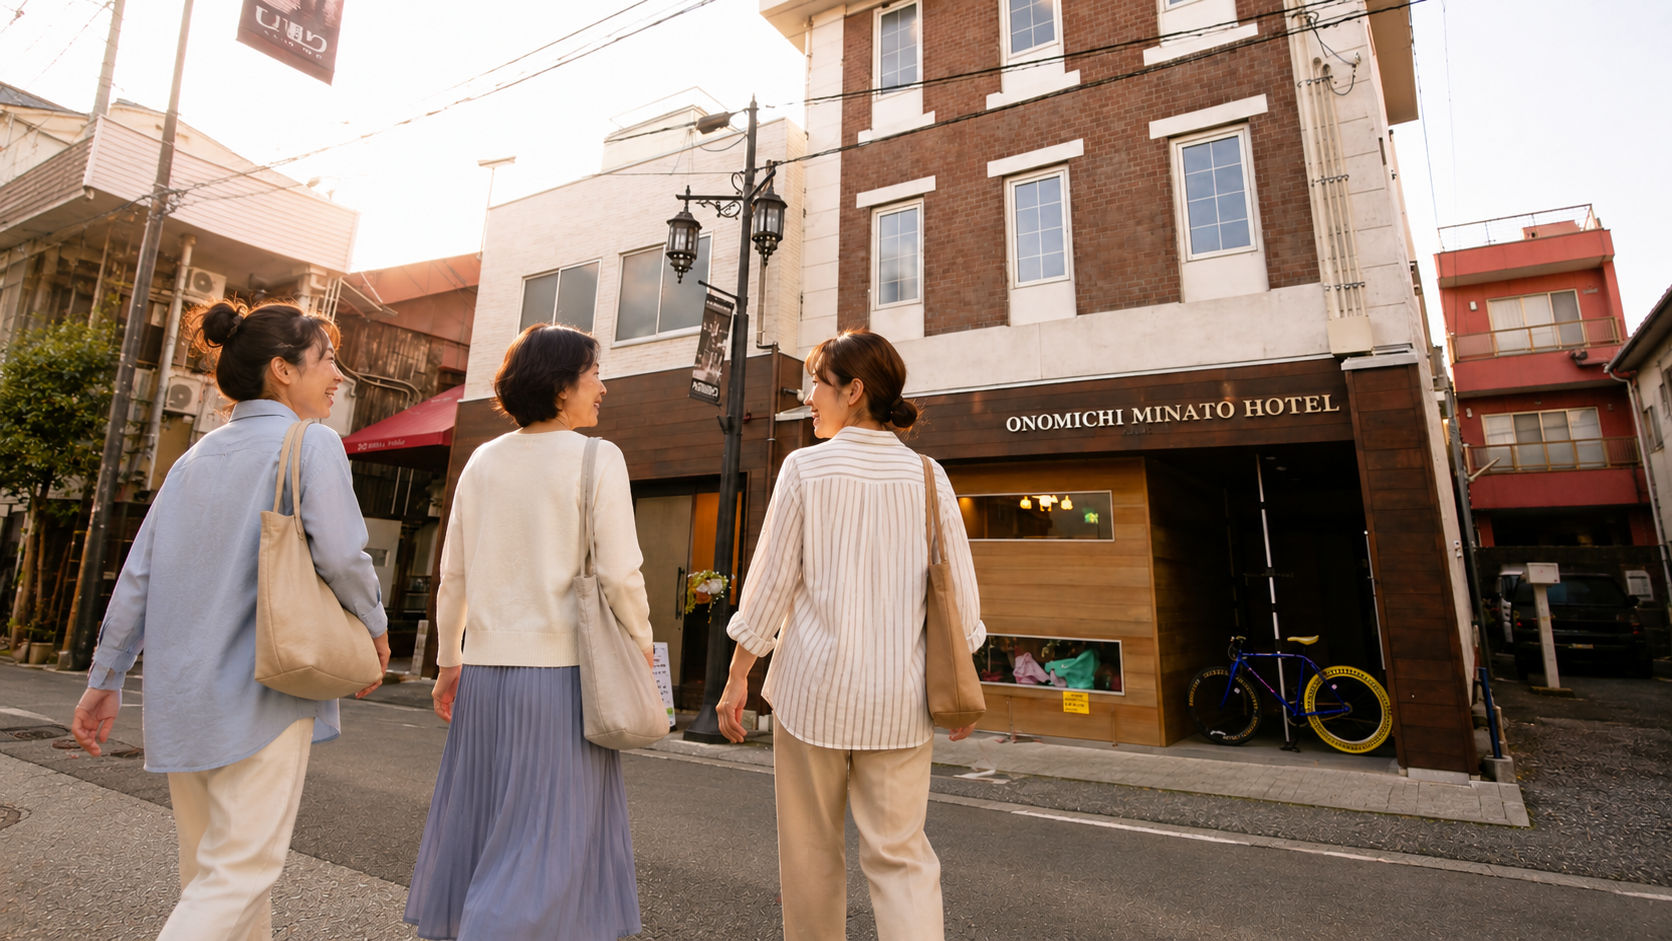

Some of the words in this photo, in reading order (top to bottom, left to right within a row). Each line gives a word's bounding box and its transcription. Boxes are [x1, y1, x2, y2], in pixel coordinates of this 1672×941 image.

[1006, 409, 1124, 432] ONOMICHI
[1131, 401, 1235, 425] MINATO
[1243, 394, 1340, 418] HOTEL
